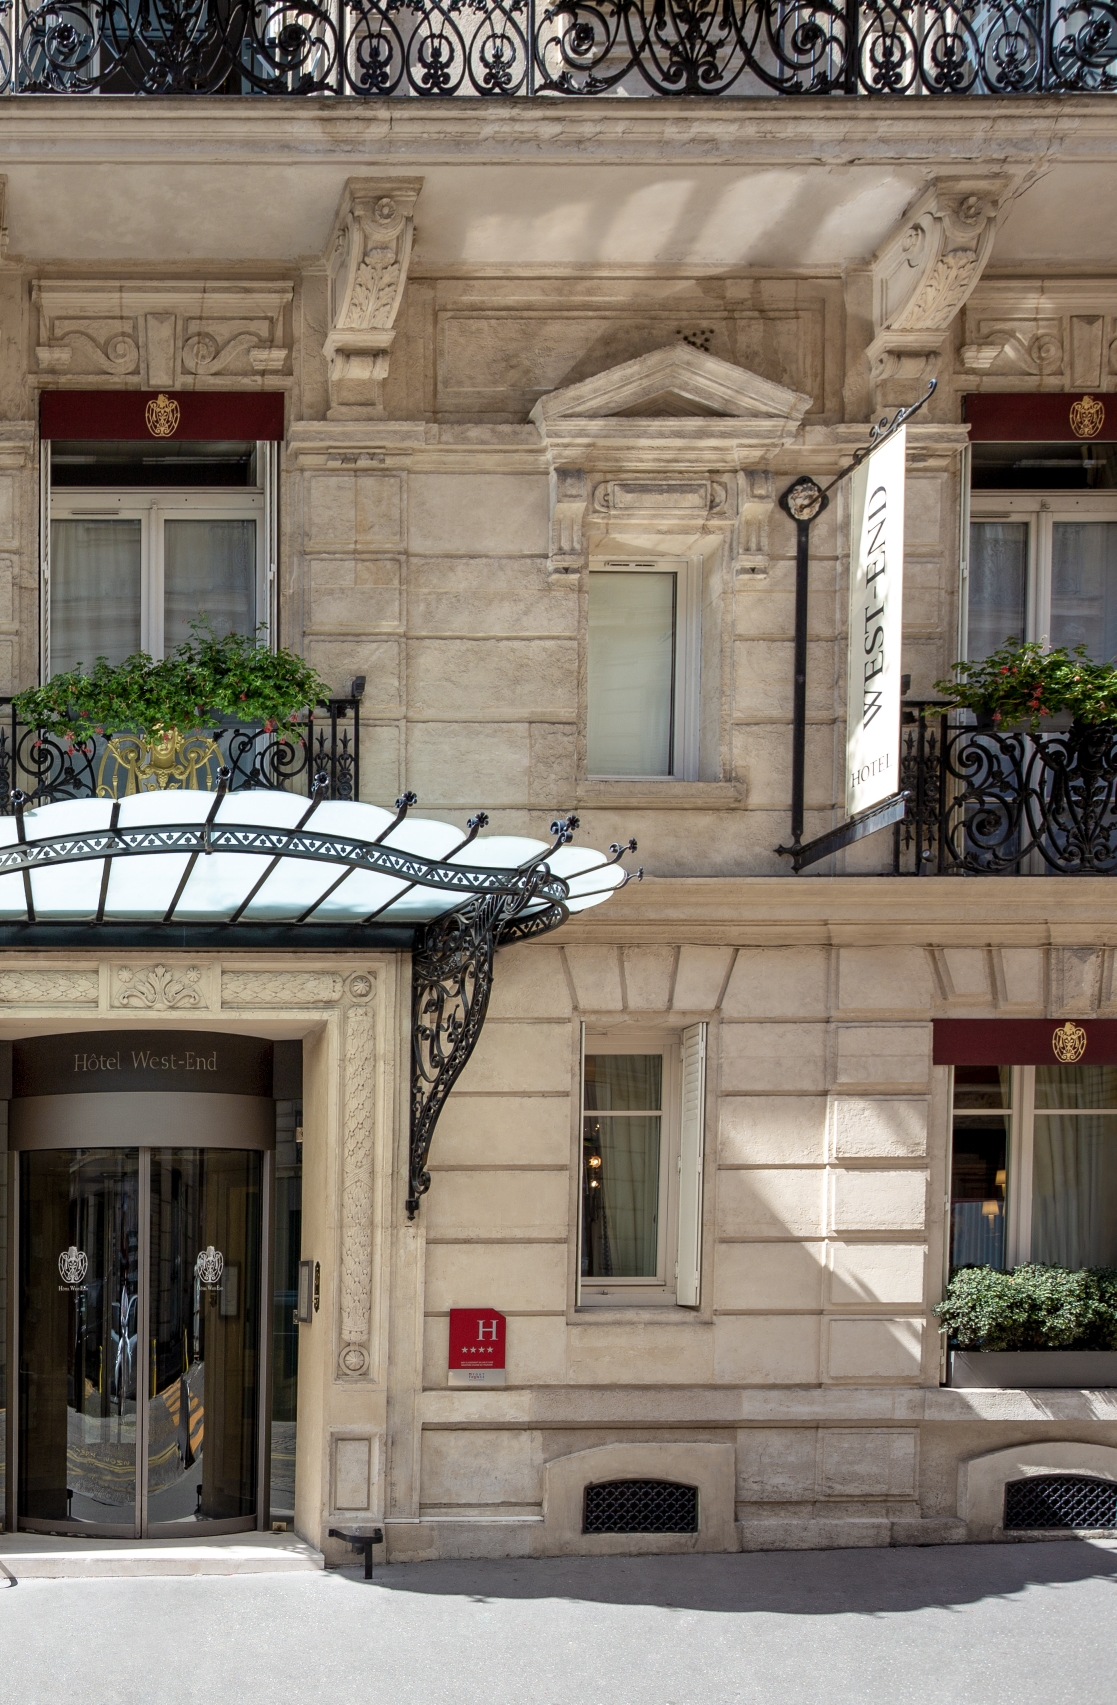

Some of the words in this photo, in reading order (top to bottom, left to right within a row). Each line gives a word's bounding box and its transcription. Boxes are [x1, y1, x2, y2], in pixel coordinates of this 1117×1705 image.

[862, 485, 887, 731] WEST-END
[850, 752, 893, 790] HOTEL
[74, 1051, 122, 1071] Hôtel
[131, 1050, 218, 1071] West-End
[477, 1319, 499, 1341] H
